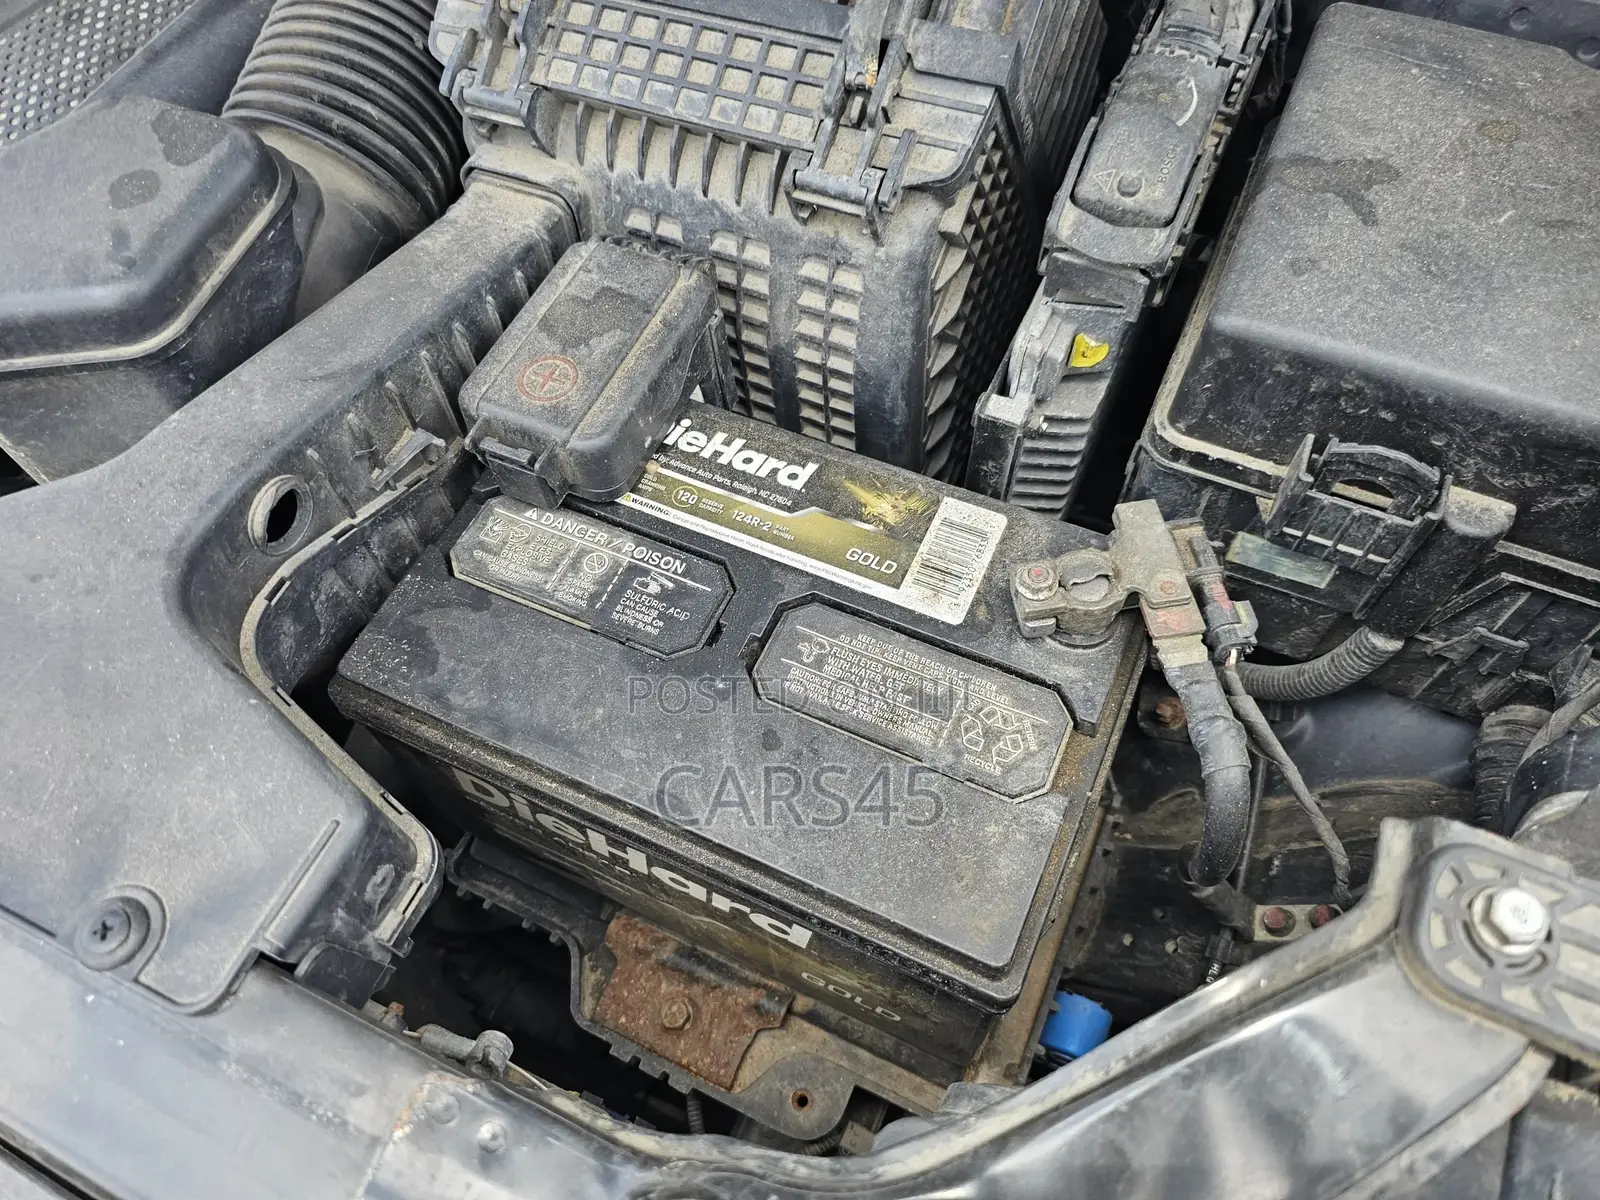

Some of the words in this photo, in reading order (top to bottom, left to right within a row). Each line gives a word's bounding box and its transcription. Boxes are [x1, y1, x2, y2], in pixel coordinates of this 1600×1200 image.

[1156, 142, 1181, 183] BOSCH
[668, 457, 697, 473] Advance
[696, 467, 713, 479] Auto
[758, 489, 769, 499] NC
[769, 493, 792, 507] 27604
[630, 497, 672, 516] WARNING:
[676, 489, 698, 505] 120
[698, 502, 723, 515] CAPACITY
[731, 508, 772, 532] 124R-2
[775, 524, 789, 533] PART
[534, 532, 565, 551] SHIELD
[541, 512, 608, 546] DANGER
[622, 542, 687, 574] POISON
[771, 528, 795, 542] NUMBER
[499, 549, 529, 566] GASES
[504, 541, 552, 565] EXPLOSIVE
[528, 542, 551, 556] EYES
[845, 548, 898, 574] GOLD
[971, 537, 989, 564] 76833
[472, 548, 488, 560] CAN
[487, 554, 508, 568] CAUSE
[508, 562, 543, 581] BLINDNESS
[489, 564, 498, 572] OR
[498, 567, 523, 581] INJURY
[577, 571, 593, 583] NO
[561, 583, 589, 599] FLAMES
[567, 576, 594, 592] SPARKS
[557, 590, 588, 607] SMOKING
[619, 597, 634, 608] CAN
[635, 603, 659, 617] CAUSE
[623, 588, 667, 611] SULFURIC
[665, 604, 691, 621] ACID
[611, 611, 637, 626] SEVERE
[637, 621, 660, 635] BURNS
[615, 603, 652, 623] BLINDNESS
[652, 618, 664, 628] OR
[826, 655, 850, 670] WITH
[850, 664, 885, 685] WATER.
[885, 677, 905, 692] GET
[830, 645, 860, 664] FLUSH
[859, 657, 882, 672] EYES
[882, 666, 943, 696] IMMEDIATELY
[839, 634, 849, 643] DO
[850, 638, 867, 650] NOT
[882, 651, 902, 663] KEEP
[902, 658, 922, 671] VENT
[922, 666, 944, 679] CAPS
[944, 674, 966, 688] TIGH
[968, 683, 985, 695] AND
[985, 690, 1010, 705] LEVEL
[856, 633, 875, 645] KEEP
[876, 640, 892, 652] OUT
[892, 646, 904, 656] OF
[904, 650, 919, 662] THE
[919, 656, 945, 672] REACH
[946, 666, 957, 676] OF
[958, 671, 996, 691] CHILDREN
[822, 663, 862, 685] MEDICAL
[861, 678, 885, 694] HELP
[884, 688, 911, 705] FAST
[789, 666, 822, 685] CAUTION:
[821, 679, 836, 690] FOR
[835, 684, 854, 697] SAFE
[853, 691, 874, 705] JUMP
[874, 699, 908, 719] STARTING
[907, 713, 938, 730] FOLLOW
[789, 682, 804, 694] NOT
[857, 710, 888, 727] SERVICE
[834, 692, 843, 701] IN
[842, 695, 871, 712] VEHICLE
[871, 707, 903, 724] OWNERS
[1021, 720, 1037, 750] RETURN
[963, 753, 1002, 774] RECYCLE
[452, 767, 812, 949] DieHard
[799, 969, 902, 1024] GOLD
